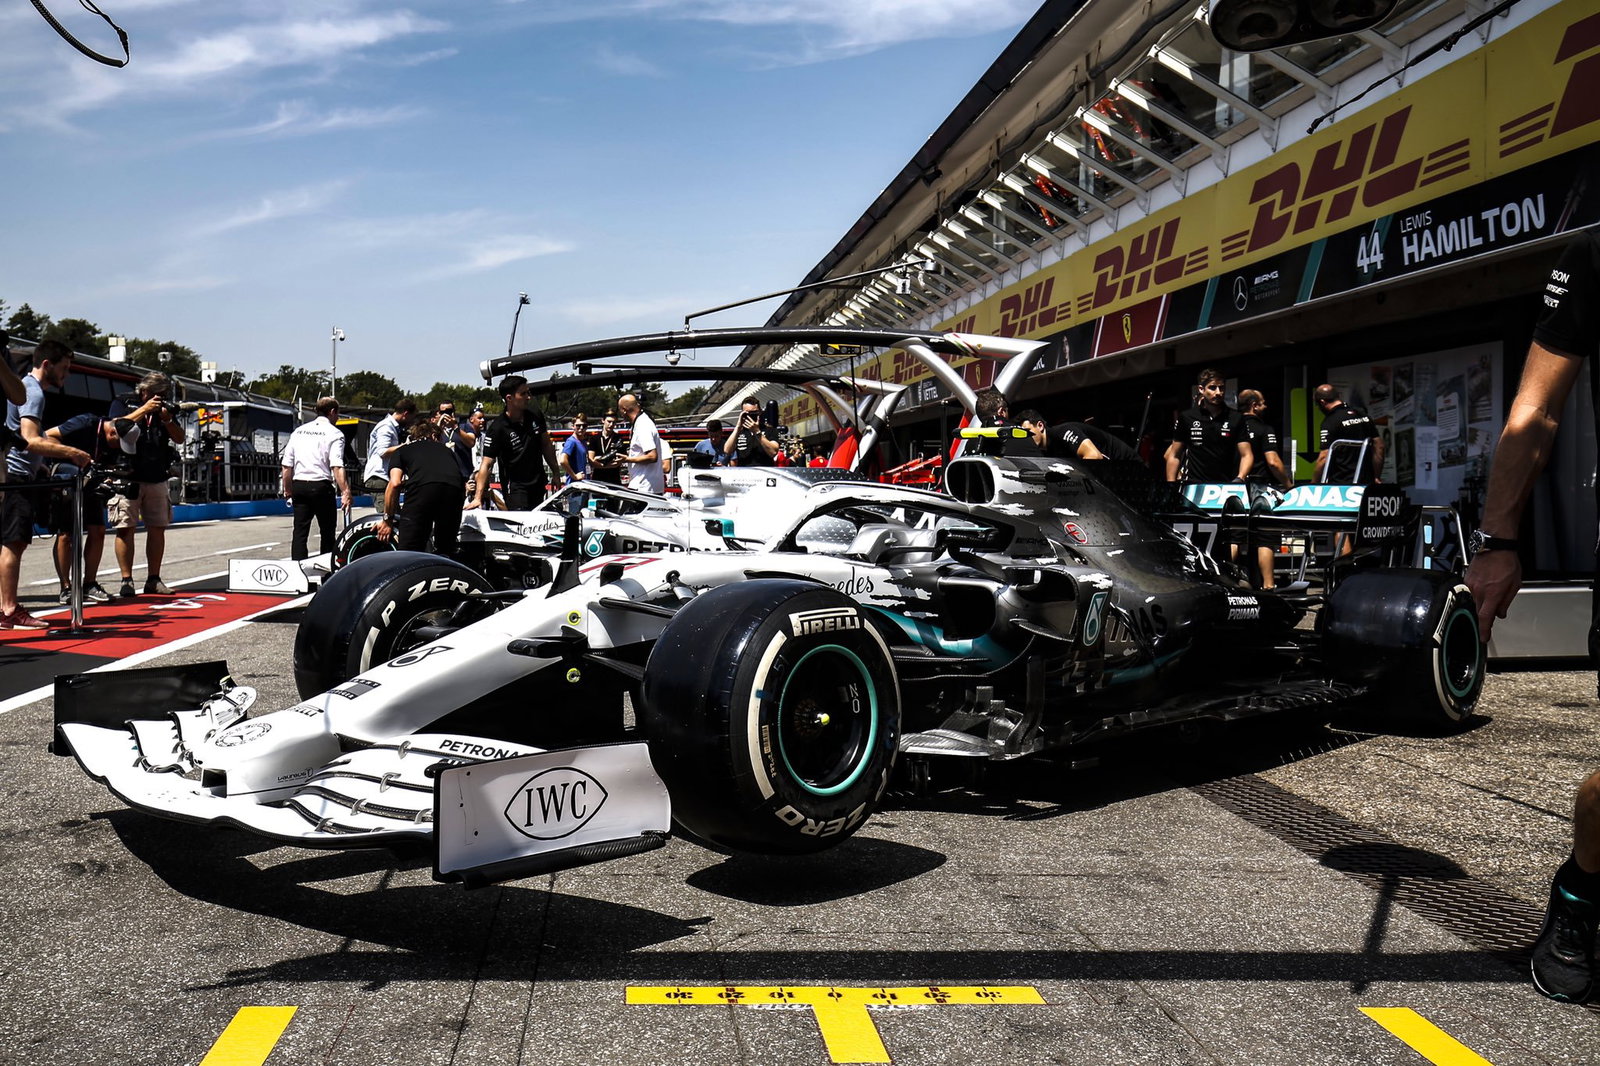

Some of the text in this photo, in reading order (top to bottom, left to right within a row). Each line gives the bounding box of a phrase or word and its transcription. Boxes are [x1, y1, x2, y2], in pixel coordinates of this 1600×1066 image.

[1246, 105, 1424, 254] DHL
[1356, 194, 1546, 274] 44 HAMILTON
[1400, 211, 1432, 233] LEWIS
[1092, 217, 1188, 309] DHL
[1000, 276, 1058, 338] DHL
[258, 568, 286, 582] IWC
[381, 600, 396, 627] P
[1227, 606, 1261, 620] PRIMAX
[1228, 596, 1259, 606] PETRONAS
[788, 607, 860, 637] PIRELLI
[524, 780, 588, 828] IWC
[775, 801, 867, 838] ZERO
